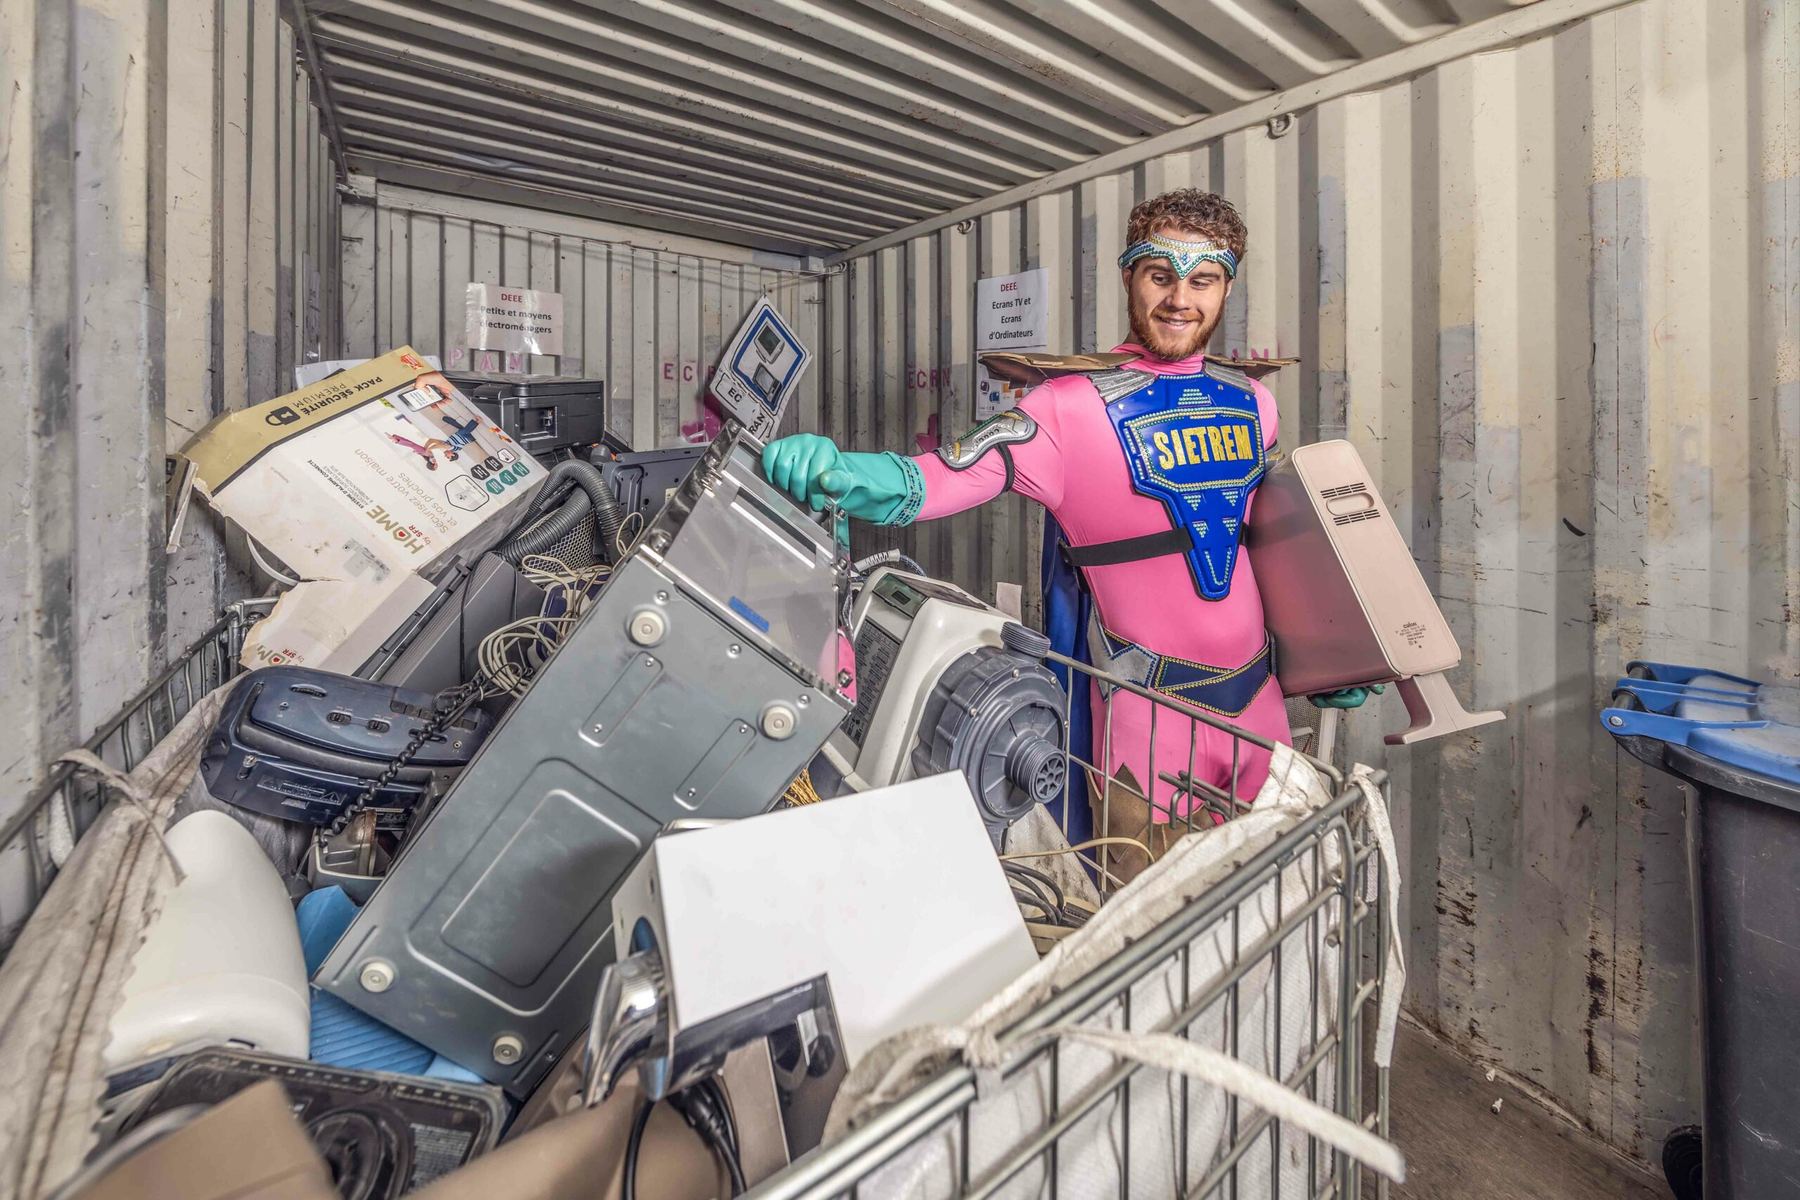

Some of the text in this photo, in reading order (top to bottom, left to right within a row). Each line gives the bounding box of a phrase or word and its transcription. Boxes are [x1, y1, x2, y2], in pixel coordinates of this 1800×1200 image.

[1000, 281, 1018, 292] DEEE
[501, 293, 523, 303] DEEE
[992, 297, 1031, 310] Ecrans TV et
[480, 306, 552, 321] Petits et moyens
[1001, 315, 1022, 324] Ecrans
[989, 330, 1034, 340] d'Ordinateurs
[293, 383, 347, 408] PREMIUM
[300, 376, 383, 416] PACK SÉCURITÉ
[1153, 425, 1254, 470] SIETREM
[354, 448, 387, 477] maison
[386, 475, 410, 497] votre
[398, 472, 458, 527] et vos proches
[409, 497, 449, 534] Sécurisez
[366, 505, 425, 555] HOME
[408, 524, 423, 538] SFR
[255, 643, 292, 665] OM
[282, 648, 297, 659] SFR
